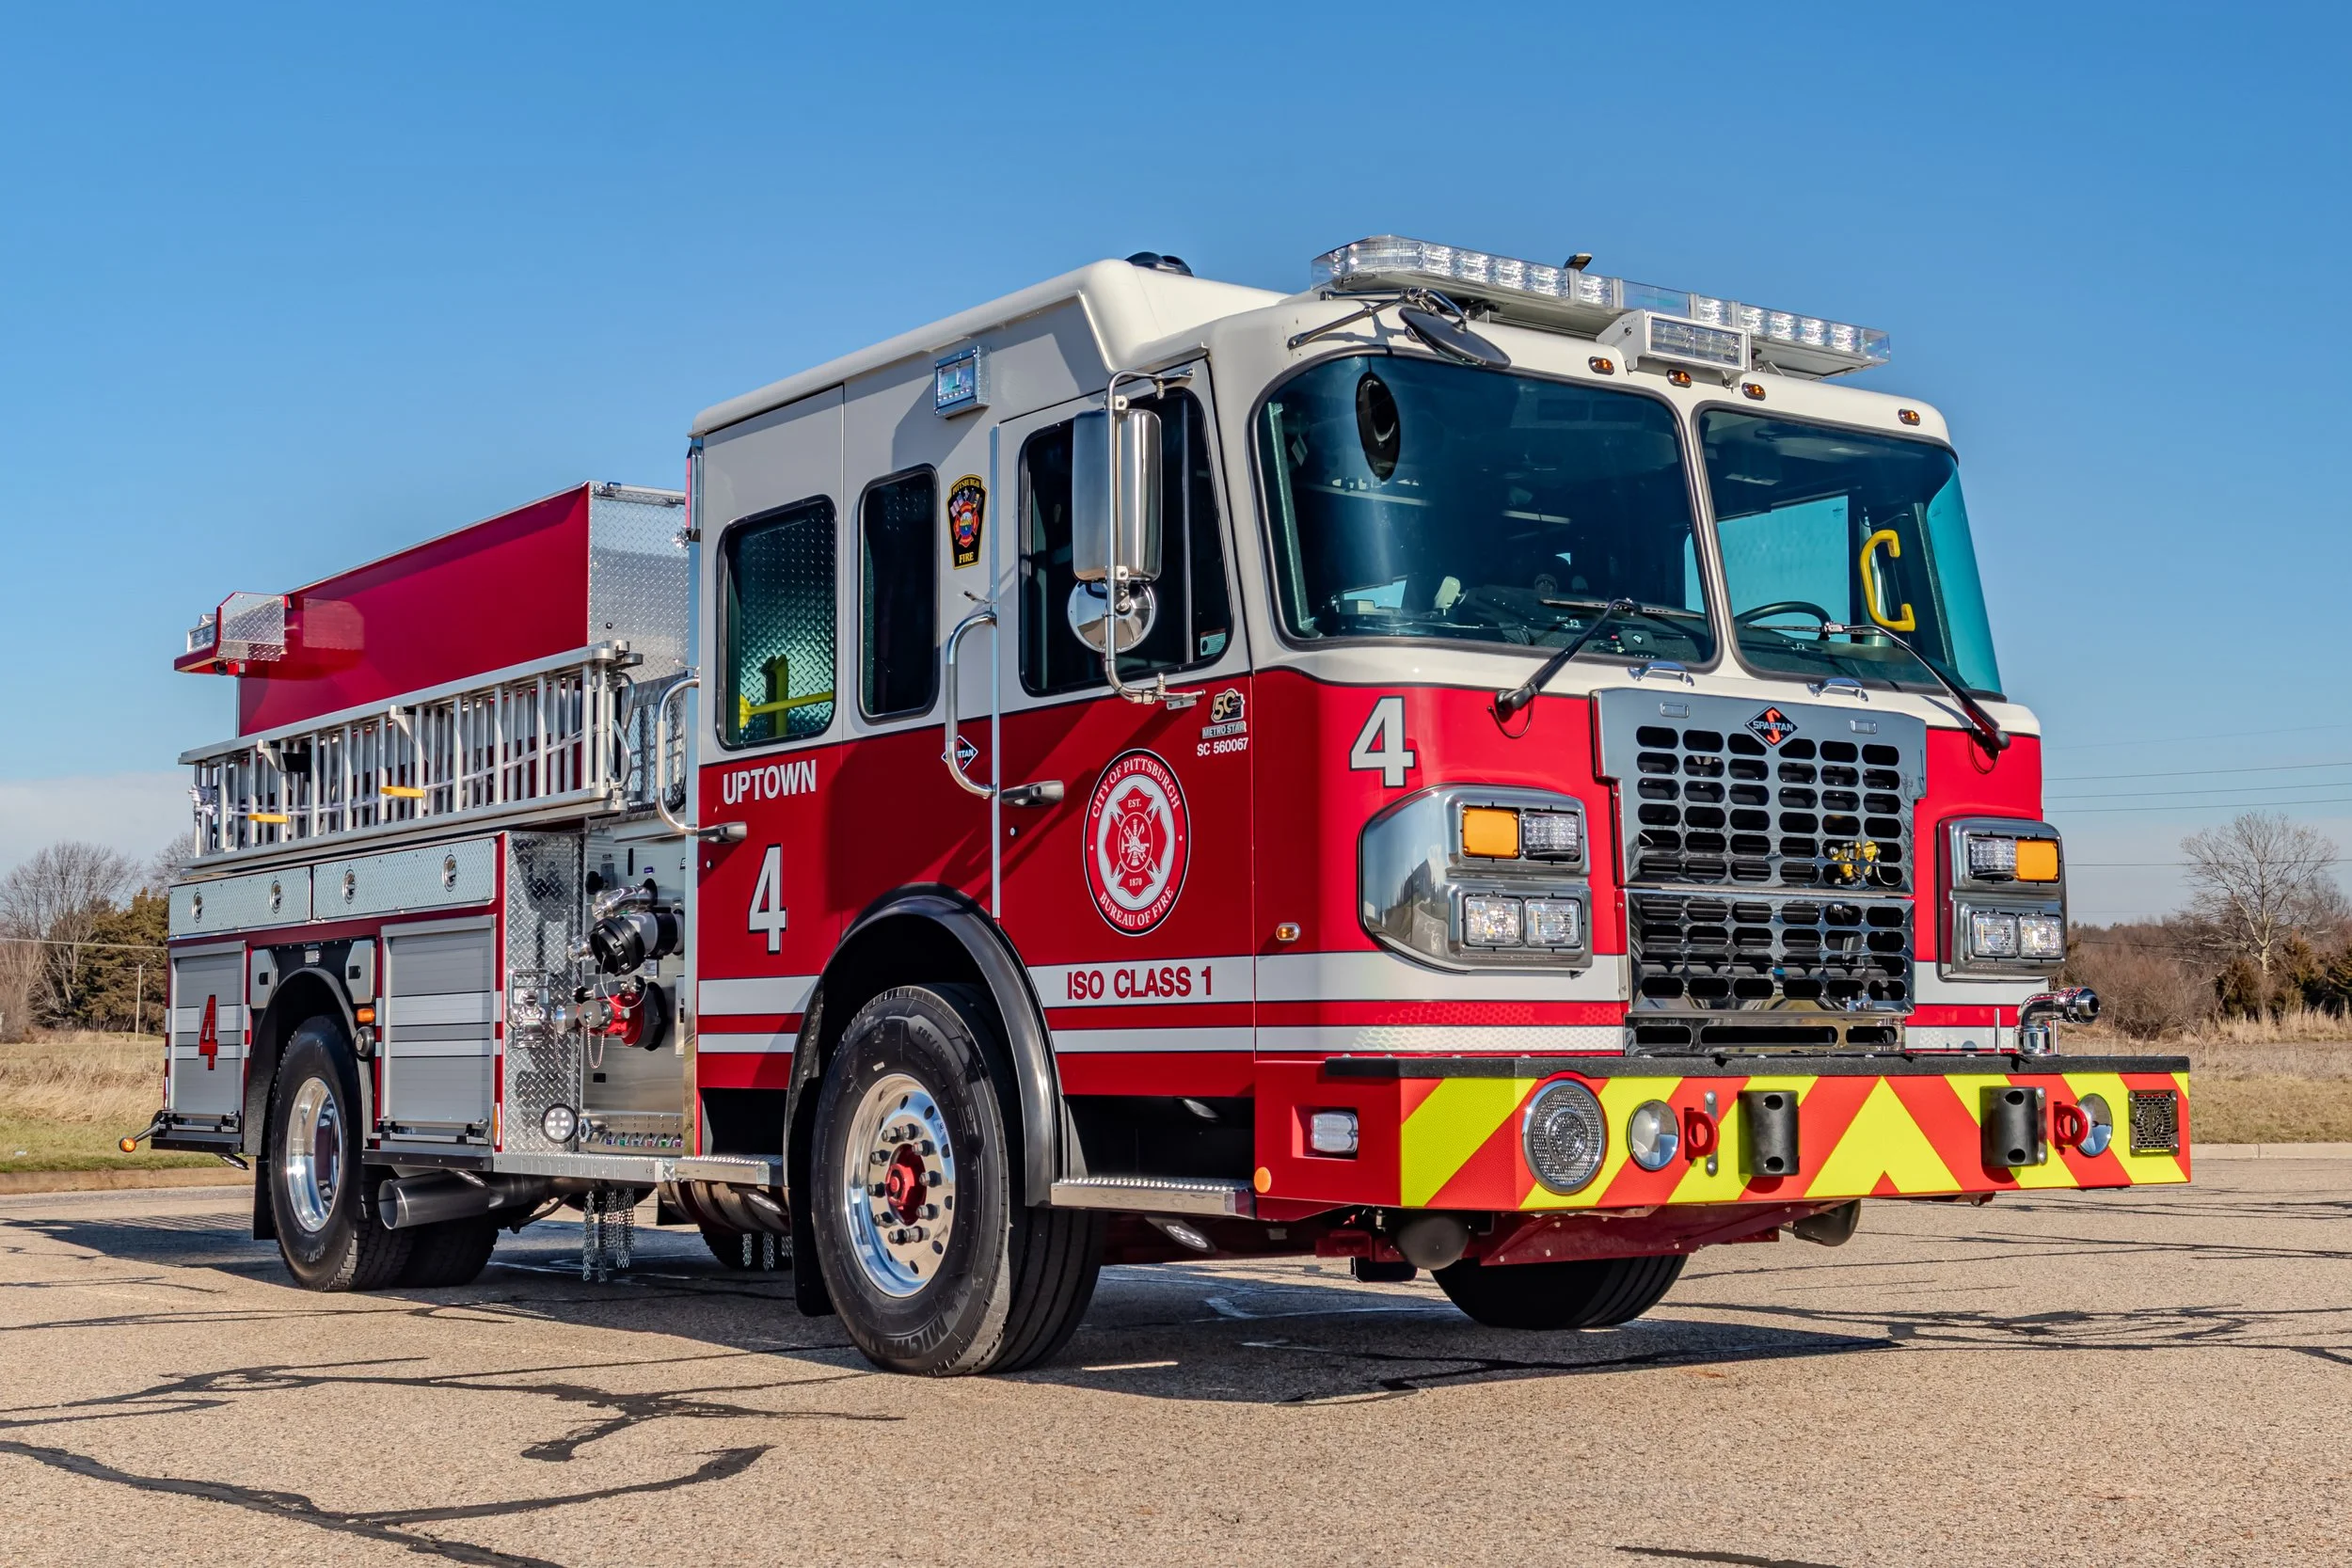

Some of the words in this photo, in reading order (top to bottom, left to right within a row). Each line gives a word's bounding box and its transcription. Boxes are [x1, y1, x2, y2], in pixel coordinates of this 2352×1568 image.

[952, 478, 980, 495] PITTSBURGH
[959, 552, 974, 563] FIRE
[1204, 726, 1226, 736] METRO
[1227, 722, 1245, 733] STAR
[1753, 721, 1793, 731] SPARTAN
[1197, 743, 1210, 756] SC
[1213, 737, 1248, 754] 560067
[1349, 695, 1415, 788] 4
[723, 758, 817, 805] UPTOWN
[1092, 780, 1109, 818] CITY
[1108, 765, 1121, 784] OF
[1123, 758, 1181, 810] PITTSBURGH
[1128, 799, 1142, 808] EST.
[1129, 878, 1142, 886] 1870
[747, 843, 787, 955] 4
[1099, 891, 1136, 927] BUREAU
[1137, 911, 1151, 927] OF
[1152, 886, 1174, 918] FIRE
[1067, 970, 1104, 1000] ISO
[1114, 966, 1192, 999] CLASS
[1200, 966, 1212, 996] 1
[199, 994, 217, 1070] 4
